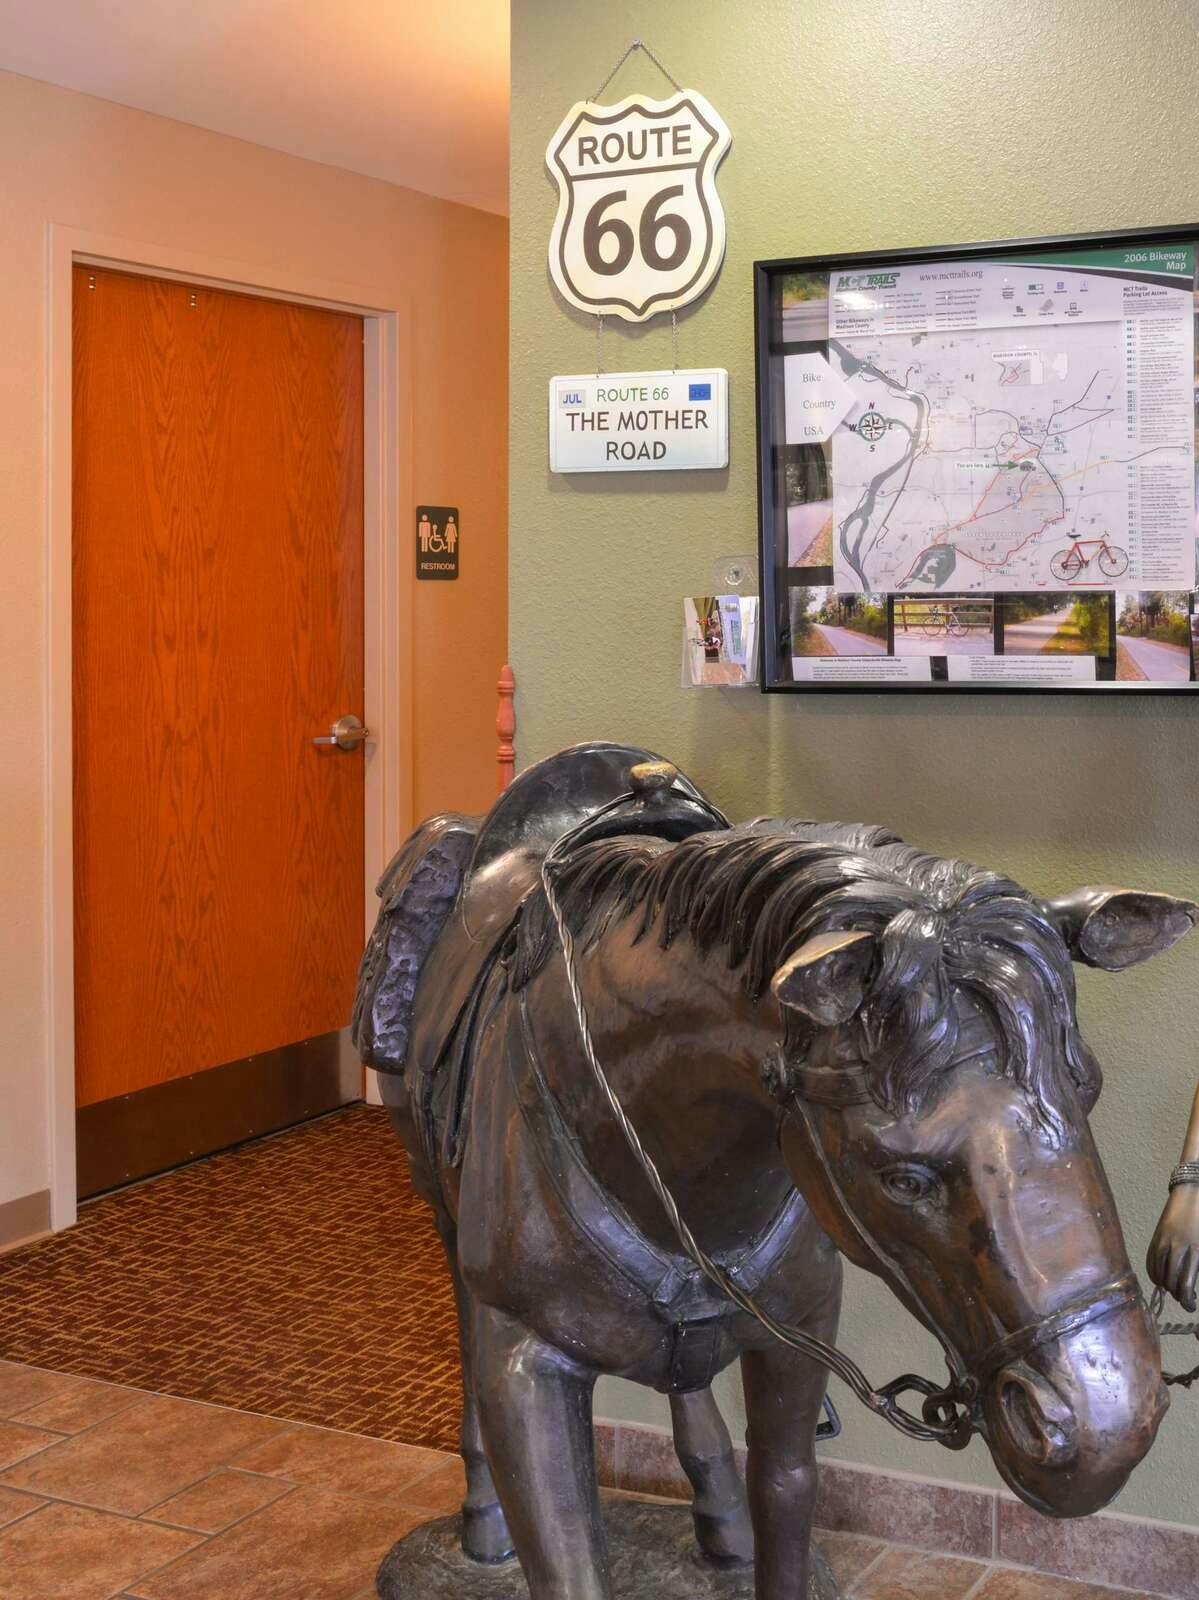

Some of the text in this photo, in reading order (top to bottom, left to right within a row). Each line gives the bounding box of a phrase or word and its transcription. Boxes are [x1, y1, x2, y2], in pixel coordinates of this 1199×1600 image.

[578, 124, 692, 167] ROUTE
[583, 184, 692, 276] 66
[1124, 251, 1187, 263] 2006 Bikeway
[1166, 261, 1186, 271] Map
[919, 270, 983, 281] www.mcttrails.org
[802, 373, 822, 383] Bike
[562, 393, 582, 404] JUL
[596, 388, 648, 402] ROUTE
[652, 387, 669, 401] 66
[803, 400, 836, 410] Country
[868, 402, 875, 410] N
[566, 409, 708, 431] THE MOTHER
[803, 426, 825, 436] USA
[849, 423, 857, 432] W
[606, 441, 667, 460] ROAD
[421, 562, 455, 571] RESTROOM
